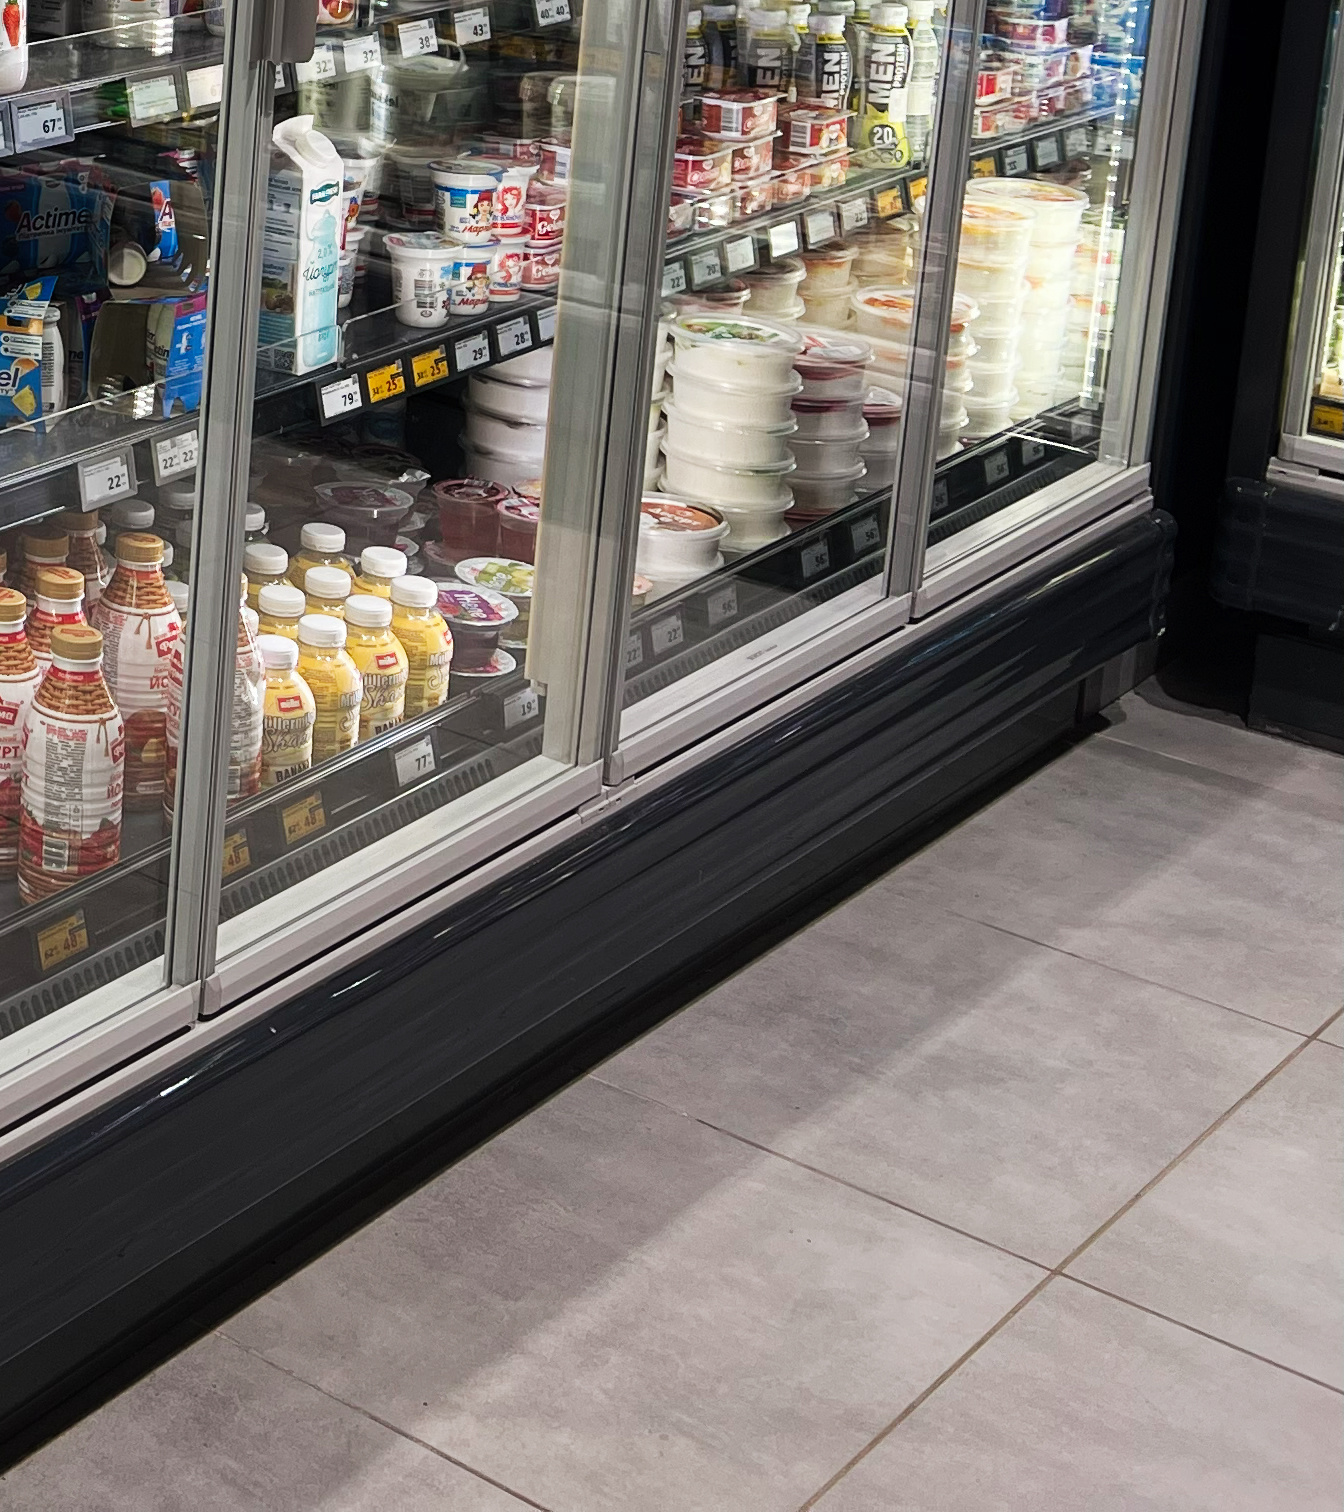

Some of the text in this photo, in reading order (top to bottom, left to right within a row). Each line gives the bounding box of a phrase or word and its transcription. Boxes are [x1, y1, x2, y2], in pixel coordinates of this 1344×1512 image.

[42, 118, 57, 134] 67
[15, 208, 91, 234] Actime
[108, 475, 123, 490] 22
